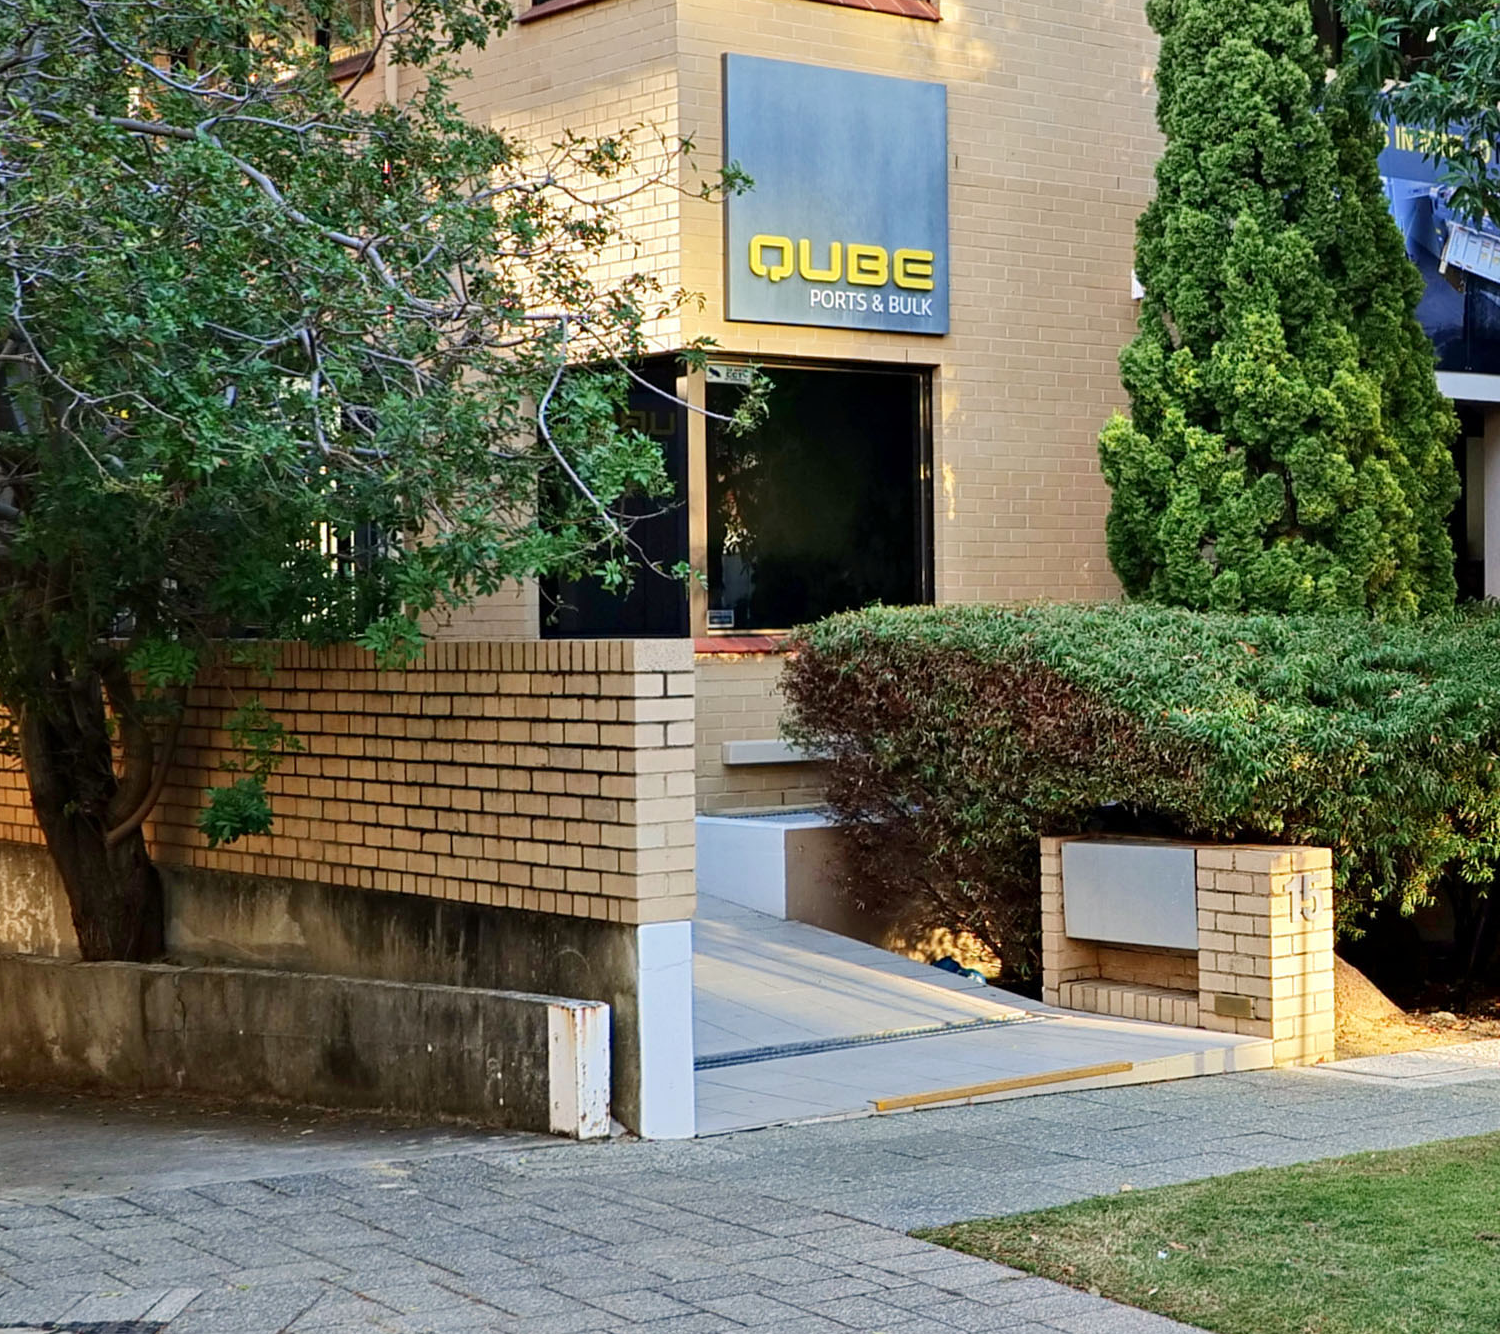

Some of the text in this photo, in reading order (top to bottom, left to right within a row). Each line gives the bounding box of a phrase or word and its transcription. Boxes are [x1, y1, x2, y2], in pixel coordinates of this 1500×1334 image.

[1395, 125, 1414, 152] IN
[749, 234, 934, 291] QUBE
[810, 289, 933, 316] PORTS & BULK
[1283, 871, 1324, 923] 15
